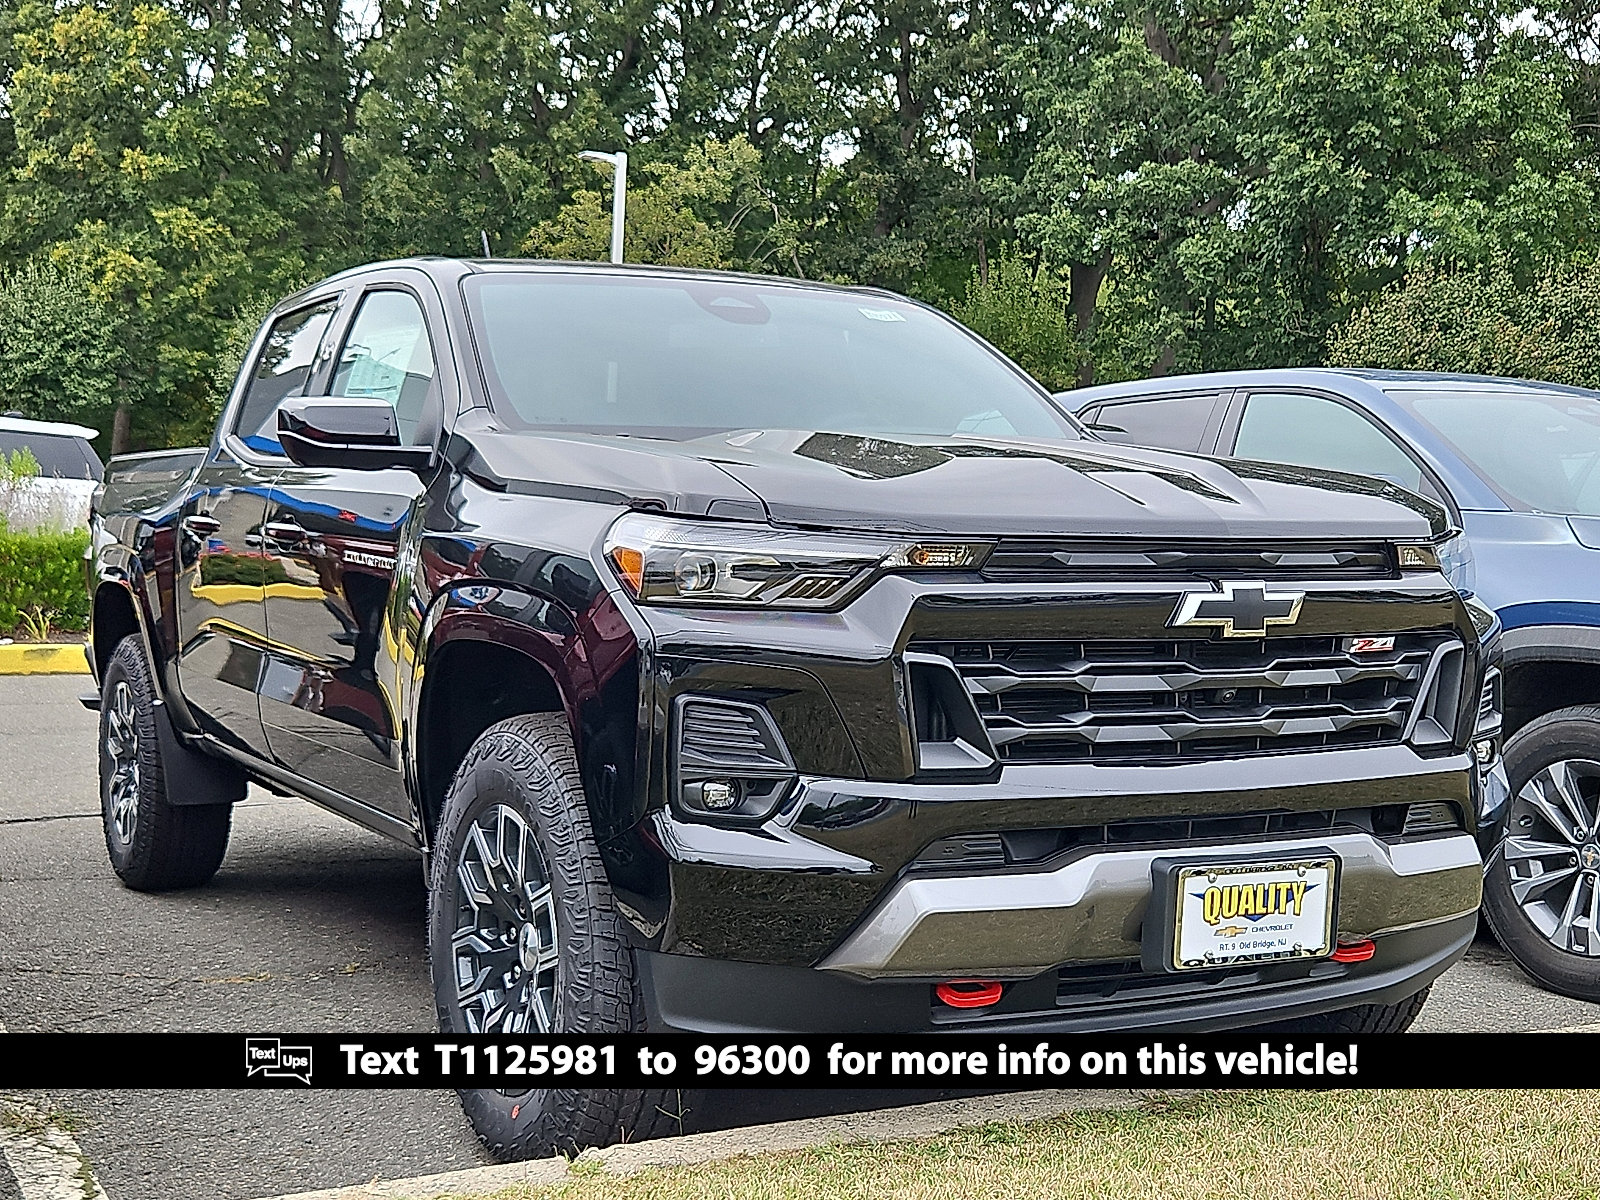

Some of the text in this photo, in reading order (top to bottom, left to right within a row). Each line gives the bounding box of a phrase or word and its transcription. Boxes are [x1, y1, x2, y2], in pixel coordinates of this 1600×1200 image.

[1203, 881, 1307, 926] QUALITY
[1252, 923, 1294, 933] CHEVROLET
[1239, 941, 1251, 950] Old
[1277, 938, 1287, 947] NJ
